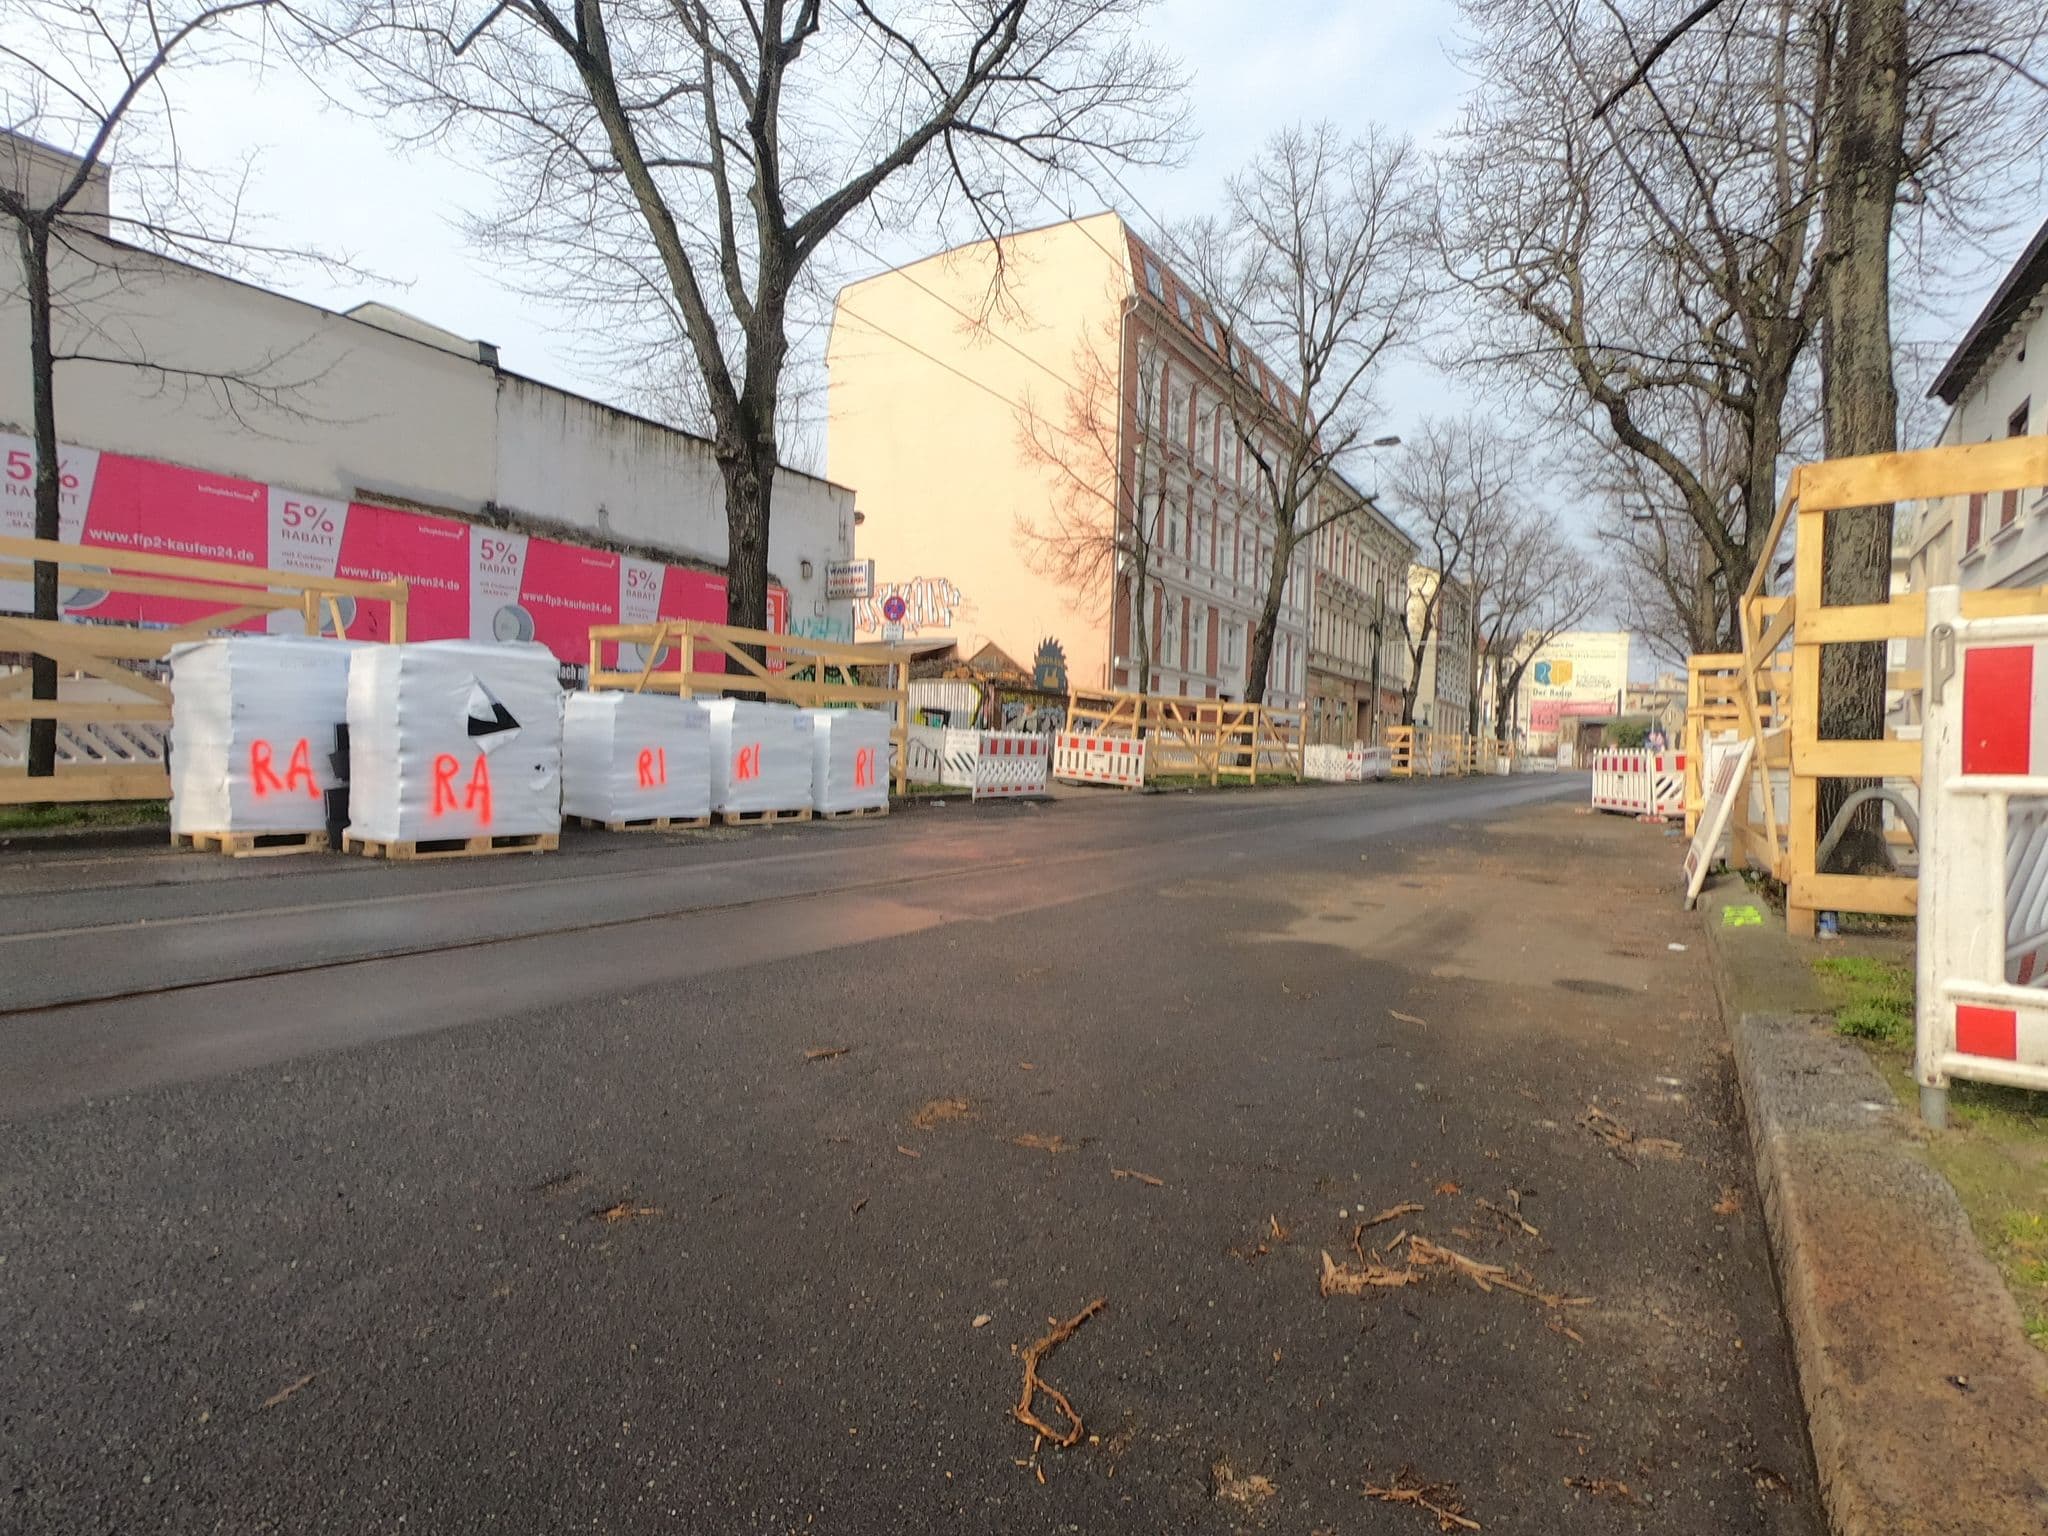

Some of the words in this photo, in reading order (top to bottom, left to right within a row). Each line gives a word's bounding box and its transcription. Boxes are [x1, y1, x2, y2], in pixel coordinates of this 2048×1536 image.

[282, 500, 334, 533] 5%
[88, 527, 255, 562] www.ffp2-kaufen24.de
[281, 527, 334, 546] RABATT
[480, 538, 518, 564] 5%
[479, 563, 518, 577] RABATT
[627, 567, 657, 591] 5%
[249, 737, 322, 800] RA
[431, 751, 494, 828] RA
